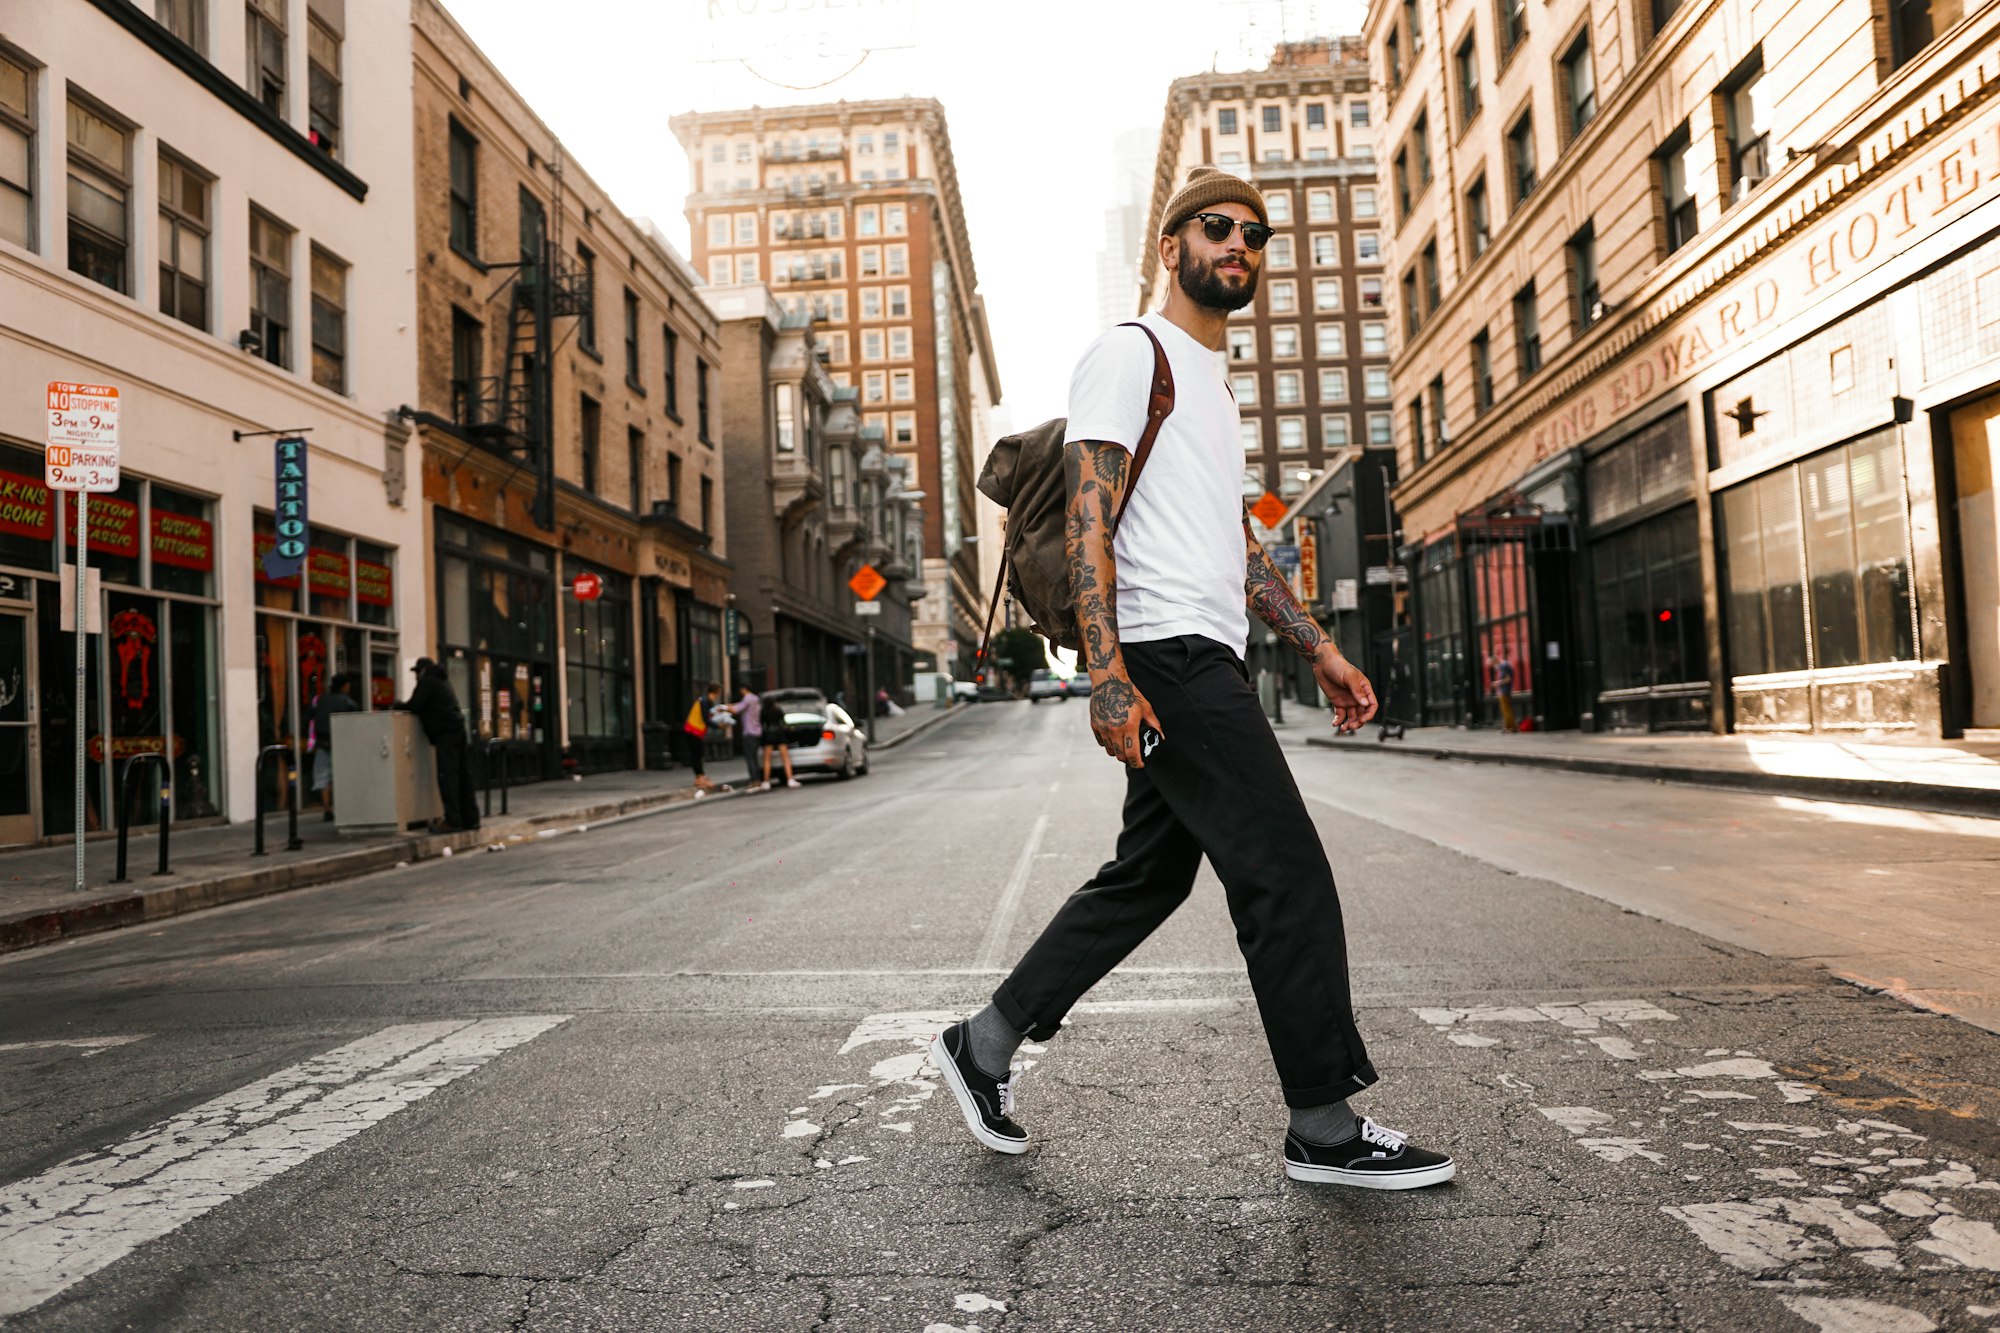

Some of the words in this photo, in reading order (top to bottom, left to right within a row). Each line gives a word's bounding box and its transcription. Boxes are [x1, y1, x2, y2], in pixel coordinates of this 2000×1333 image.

[1609, 278, 1779, 417] EDWARD
[49, 391, 69, 410] NO
[71, 397, 116, 413] STOPPING
[51, 412, 78, 428] 3PM
[89, 415, 114, 430] 9AM
[66, 430, 99, 438] NIGHTLY
[49, 447, 69, 465] NO
[71, 452, 116, 468] PARKING
[52, 467, 77, 483] 9AM
[88, 470, 113, 485] 3PM
[278, 442, 305, 557] TATTOO
[72, 527, 132, 547] ASSIC
